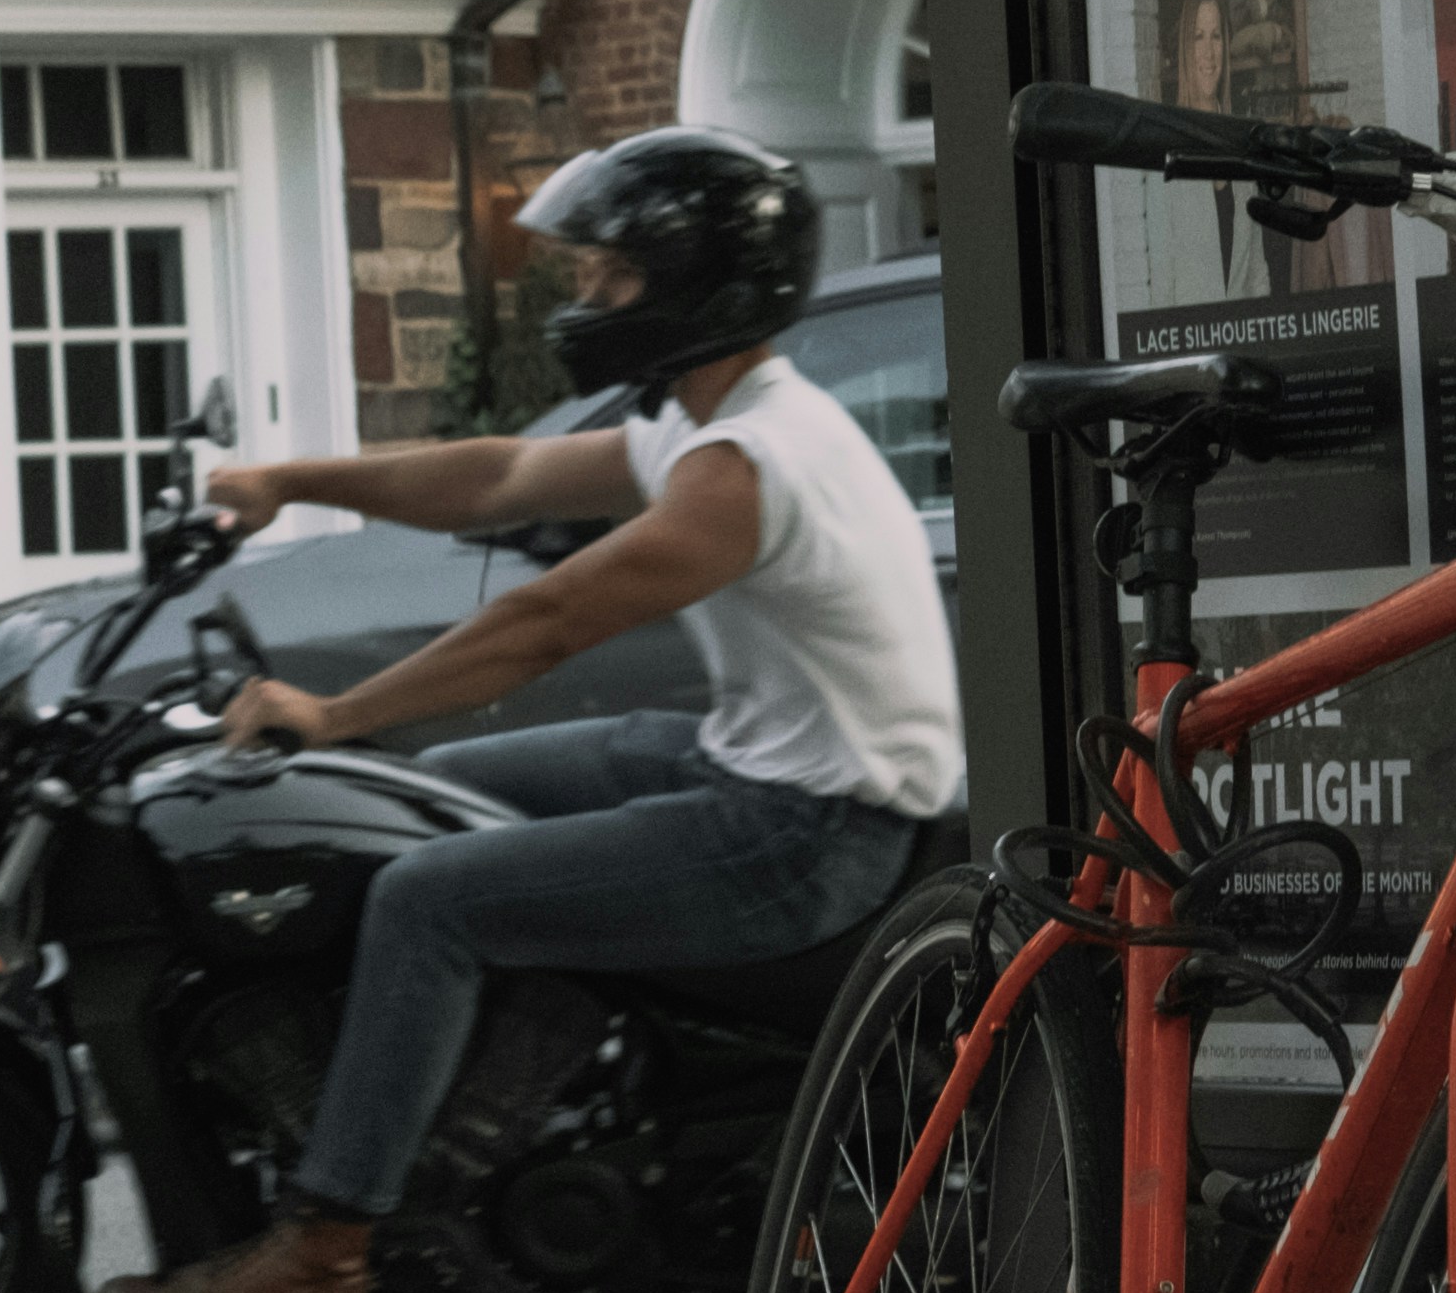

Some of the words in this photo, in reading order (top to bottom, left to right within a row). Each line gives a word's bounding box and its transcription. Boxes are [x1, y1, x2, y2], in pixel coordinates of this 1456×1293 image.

[1137, 327, 1180, 354] LACE
[1185, 314, 1297, 349] SILHOUETTES
[1302, 304, 1380, 336] LINGERIE
[1234, 872, 1319, 895] BUSINESSES
[1380, 871, 1431, 893] MONTH
[1322, 953, 1353, 969] stories
[1356, 953, 1388, 969] behind
[1239, 1044, 1292, 1062] promotions
[1294, 1046, 1311, 1061] and
[1313, 1046, 1333, 1061] stor
